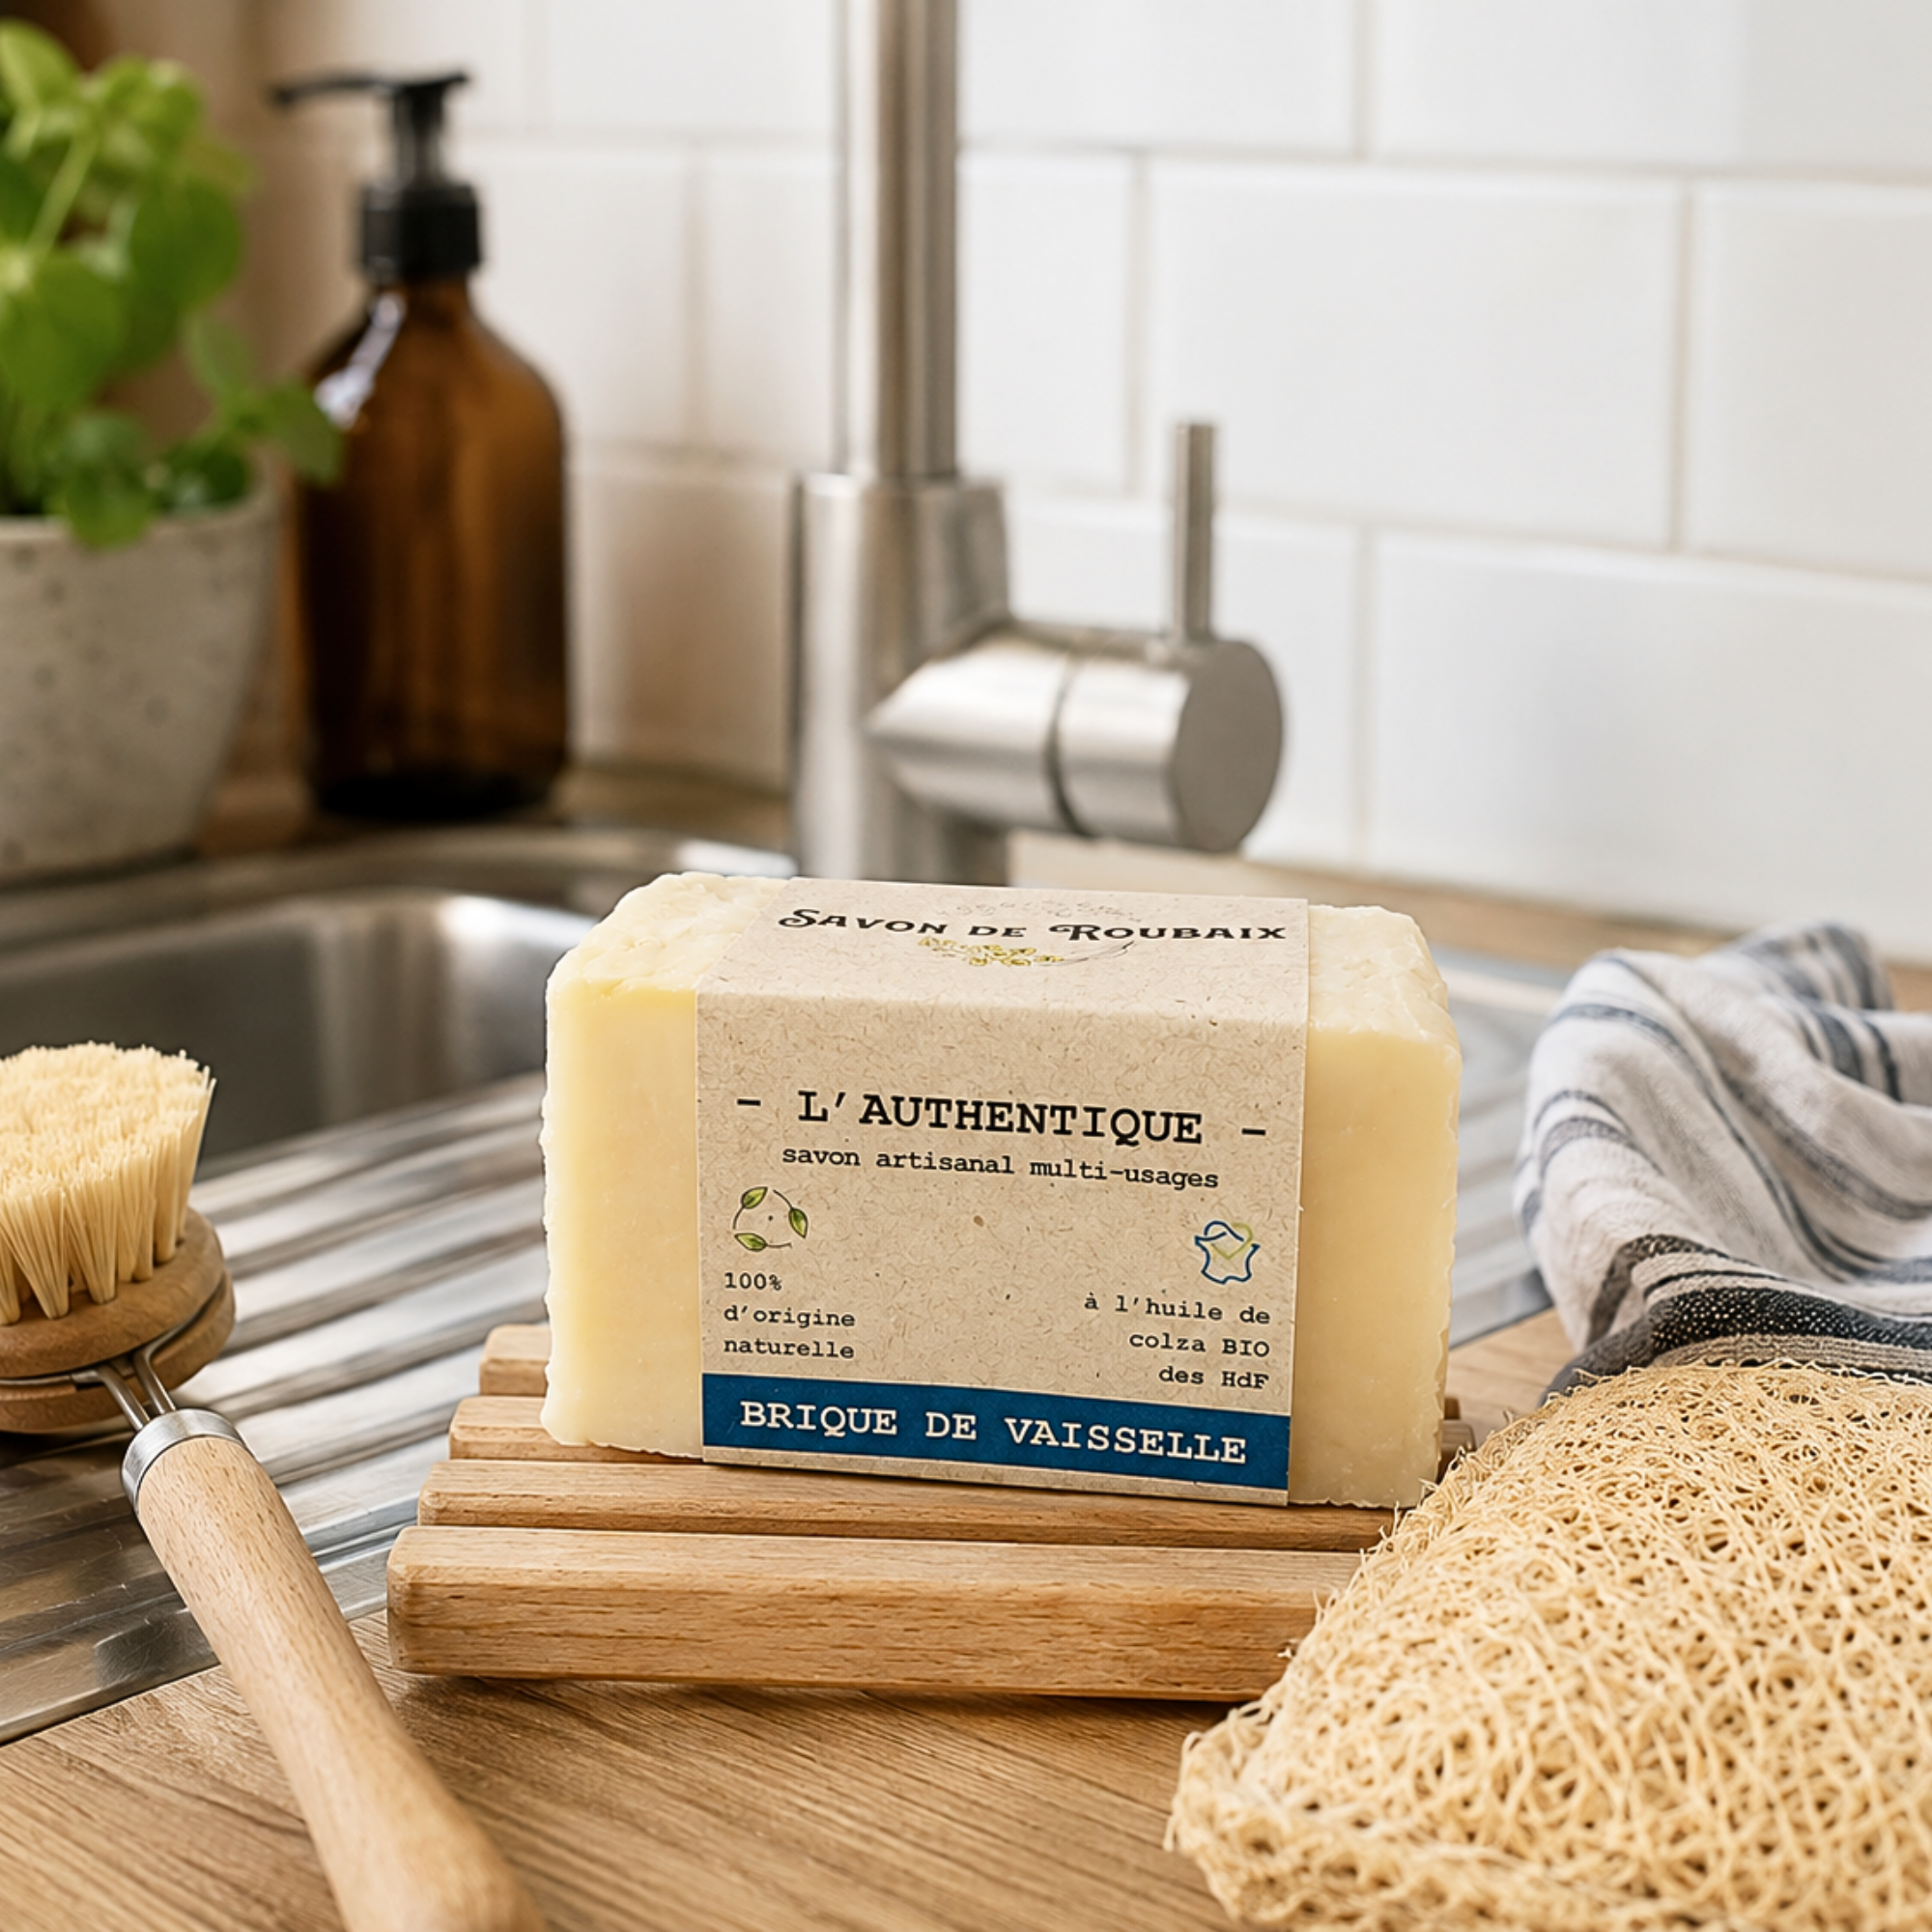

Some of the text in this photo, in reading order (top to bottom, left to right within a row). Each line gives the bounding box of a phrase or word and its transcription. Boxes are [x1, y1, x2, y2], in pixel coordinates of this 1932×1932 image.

[779, 909, 1285, 941] SAVON DE ROUBAIX
[782, 1148, 1219, 1191] savon artisanal multi-usages
[724, 1271, 782, 1292] 100%
[724, 1304, 856, 1329] d'origine
[1084, 1292, 1270, 1324] à l'huile de
[724, 1338, 855, 1359] naturelle
[1129, 1332, 1270, 1358] colza BIO
[1158, 1365, 1269, 1390] des HdF
[740, 1401, 1246, 1464] BRIQUE DE VAISSELLE
